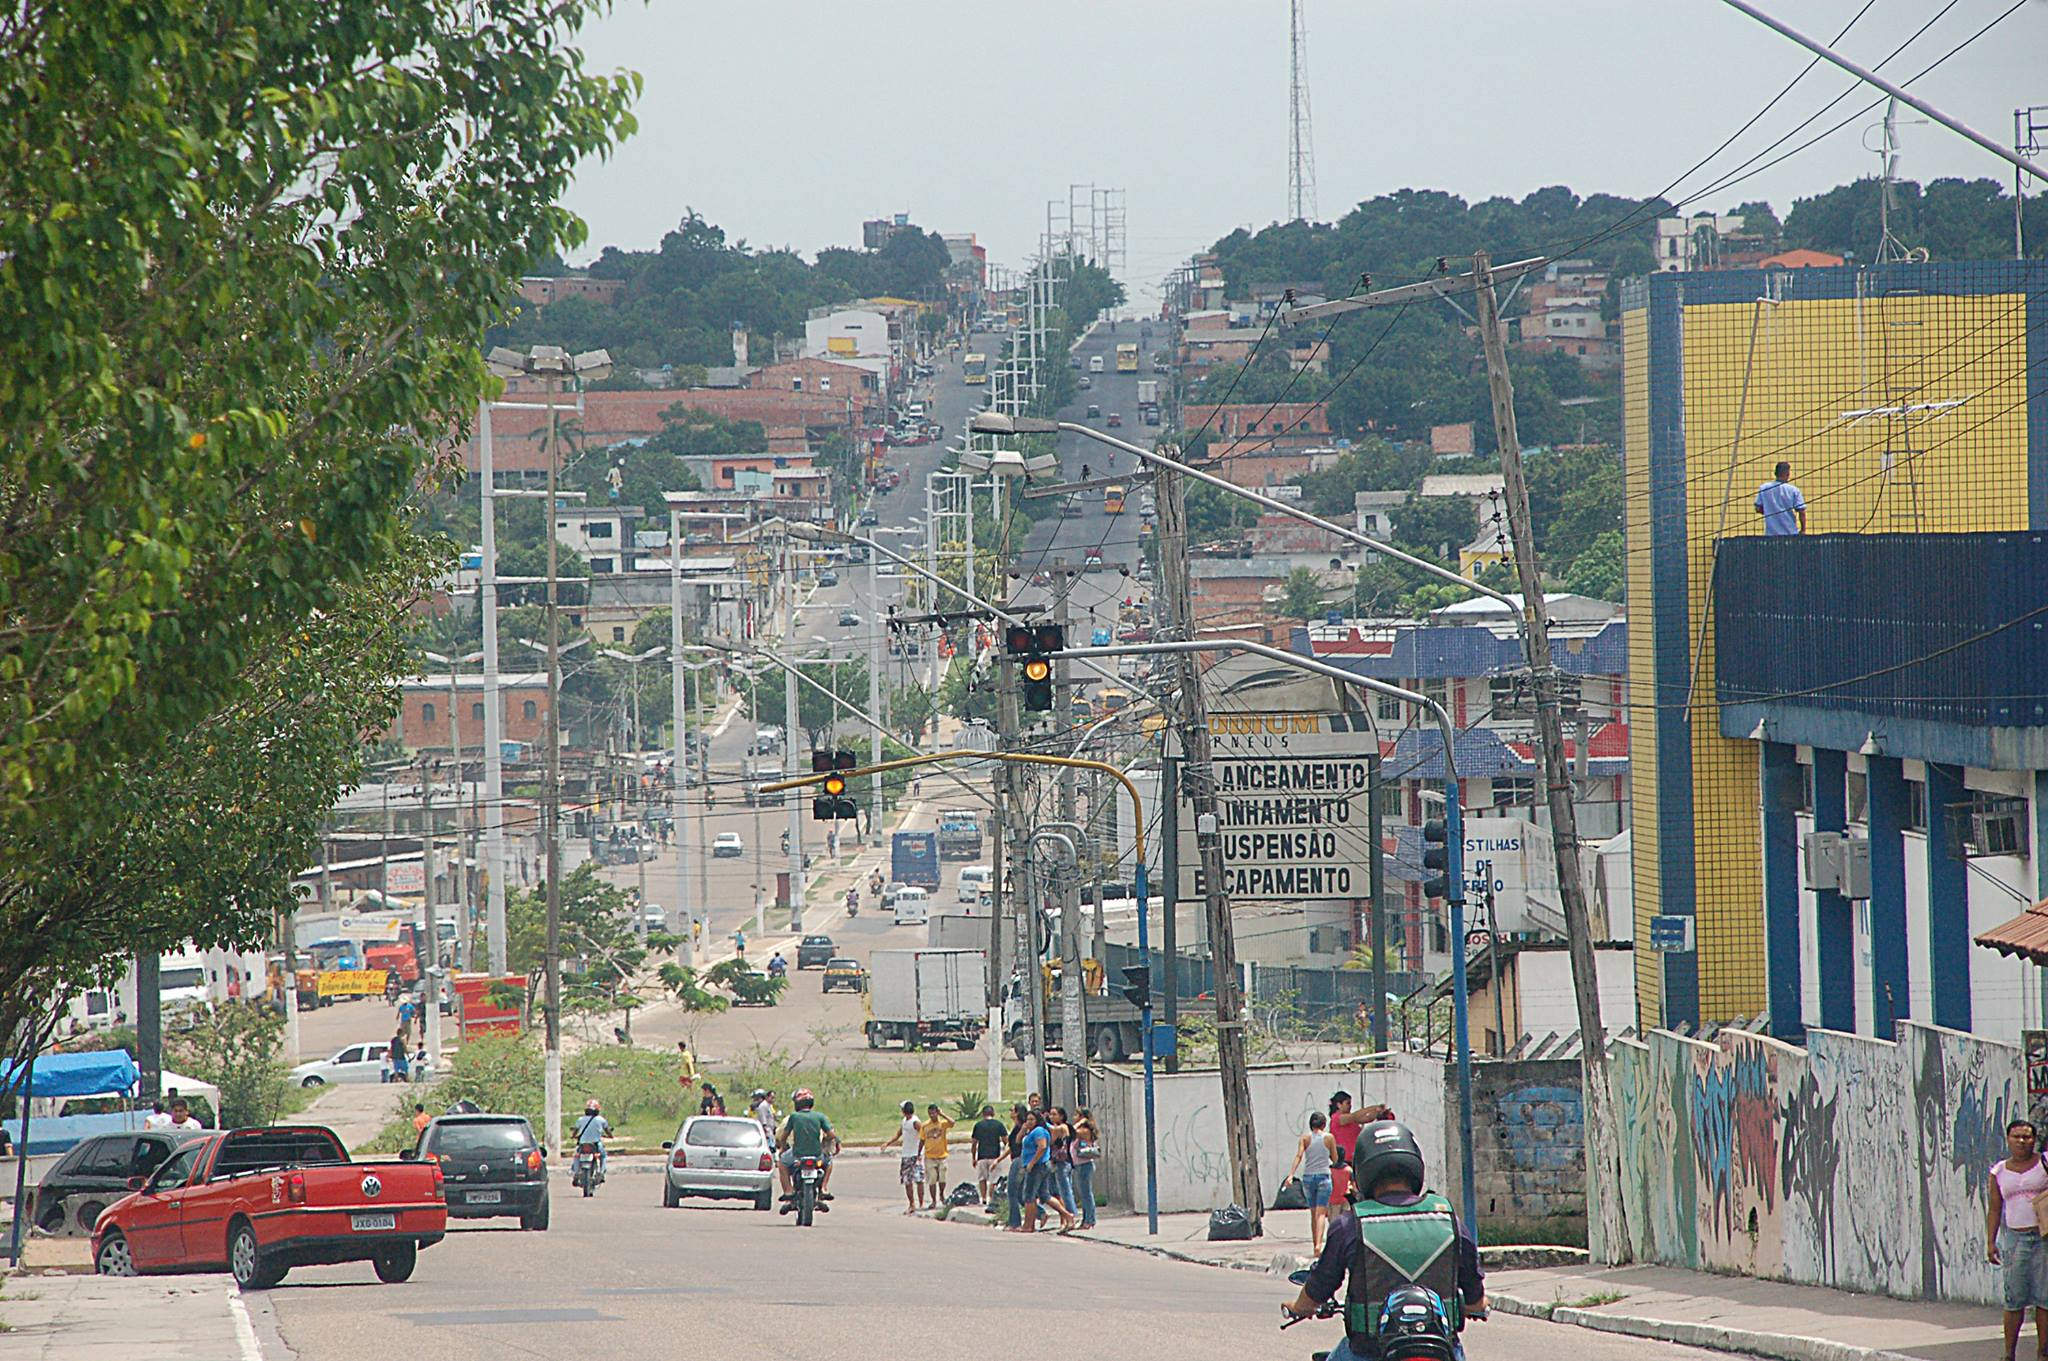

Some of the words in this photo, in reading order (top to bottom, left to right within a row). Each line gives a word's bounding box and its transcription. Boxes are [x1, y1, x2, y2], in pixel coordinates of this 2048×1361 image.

[1208, 715, 1321, 735] ODIUM
[1213, 736, 1290, 749] PNEUS
[1214, 763, 1365, 791] ANCEAMENTO
[1219, 798, 1349, 826] INHAMENTO
[1224, 828, 1336, 860] USPENSÃO
[1465, 838, 1520, 852] STILHAS
[1194, 867, 1351, 896] ECAPAMENTO
[1463, 879, 1504, 892] FREO
